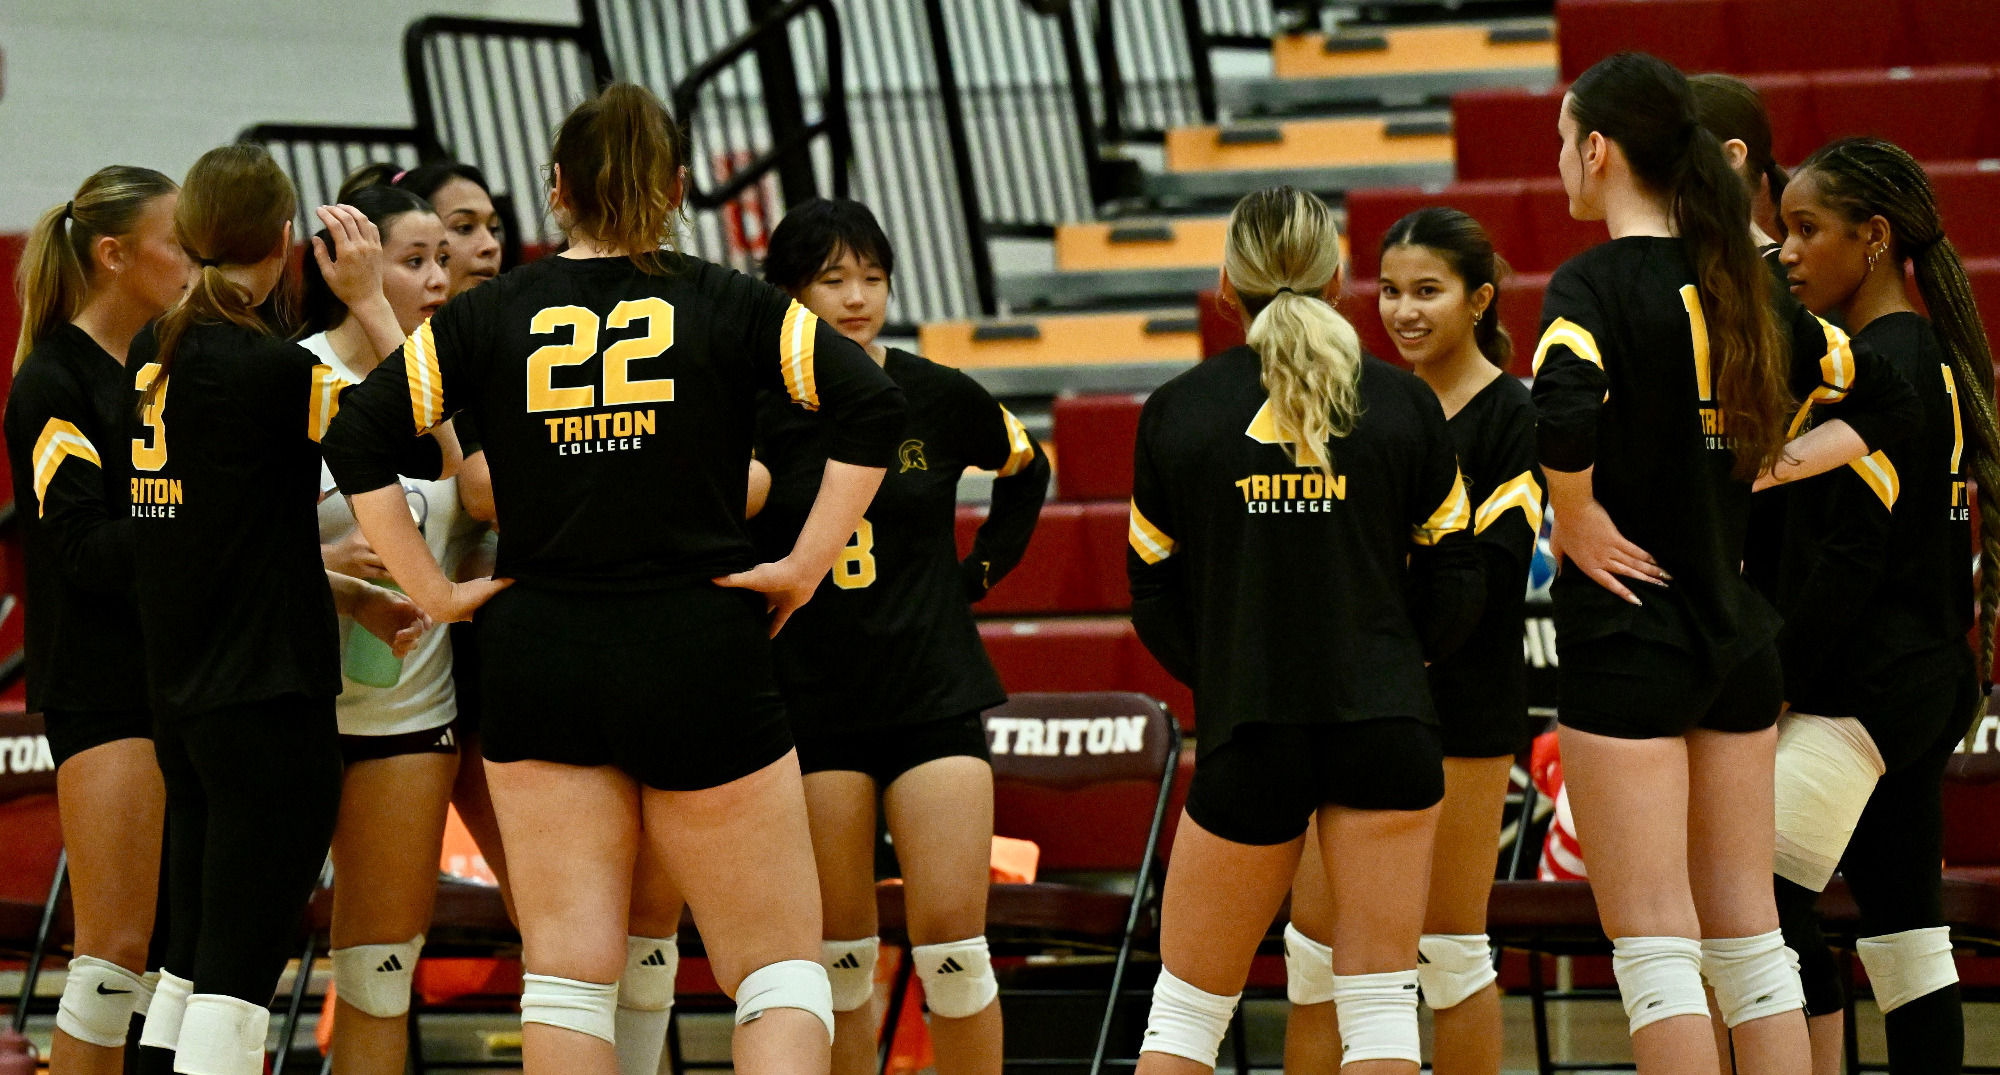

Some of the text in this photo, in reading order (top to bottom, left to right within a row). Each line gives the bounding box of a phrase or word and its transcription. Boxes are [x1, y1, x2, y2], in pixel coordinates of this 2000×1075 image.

[527, 297, 675, 413] 22
[132, 362, 170, 471] 3
[544, 409, 656, 443] TRITON
[1699, 408, 1725, 435] TRI
[559, 437, 642, 456] COLLEGE
[131, 477, 183, 505] RITON
[1235, 474, 1347, 503] TRITON
[131, 504, 176, 518] OLLEGE
[1248, 500, 1332, 514] COLLEGE
[832, 516, 877, 590] 8
[987, 715, 1148, 756] TRITON
